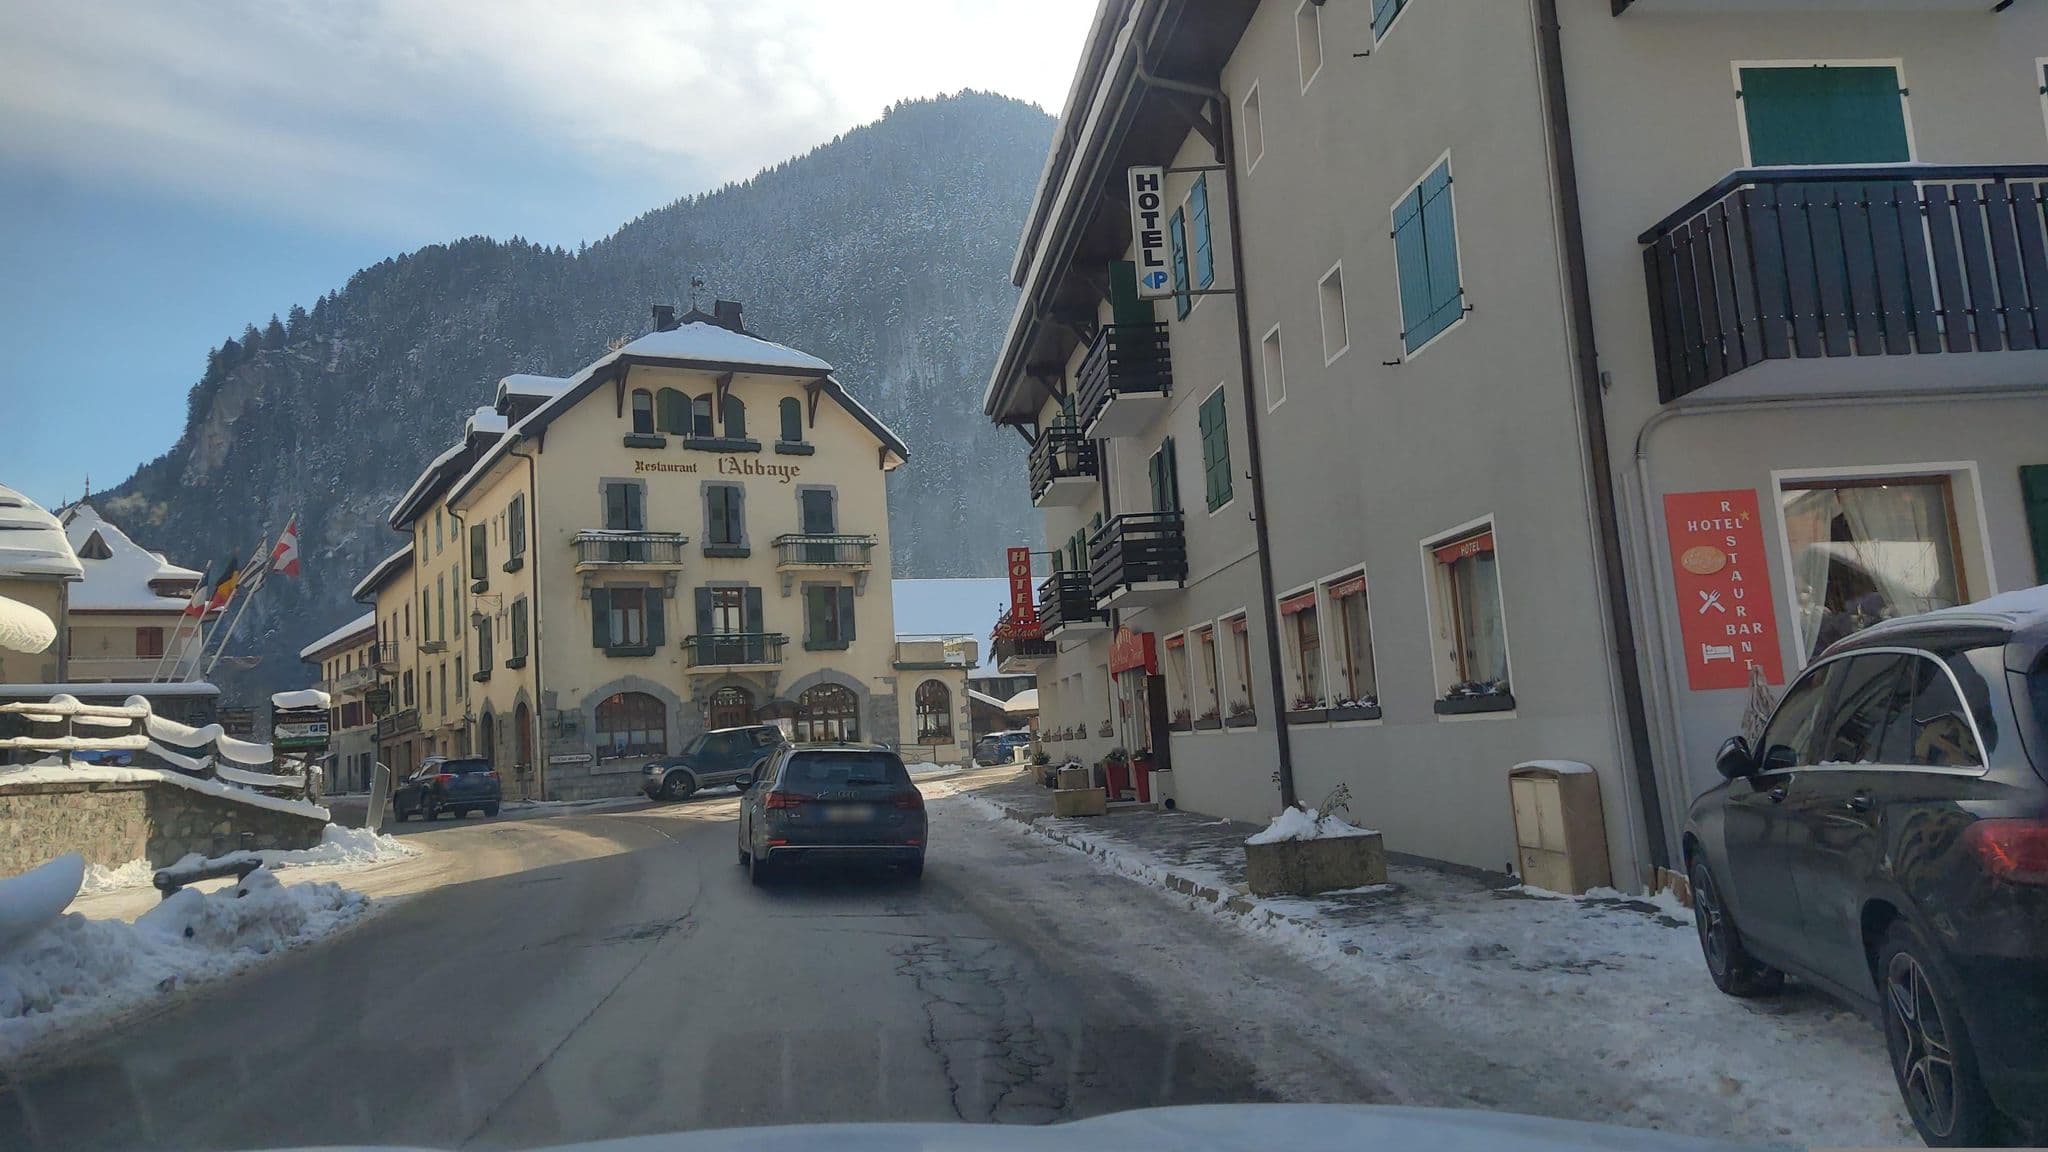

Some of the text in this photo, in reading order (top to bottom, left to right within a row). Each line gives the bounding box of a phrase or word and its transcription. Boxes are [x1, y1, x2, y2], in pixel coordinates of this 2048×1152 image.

[1135, 173, 1164, 267] HOTEL
[1153, 271, 1168, 290] P
[634, 456, 801, 484] Restaurant l'Abbaye
[1687, 518, 1744, 532] HOTEL
[1011, 551, 1029, 618] HOTEL
[1725, 621, 1763, 636] BAR
